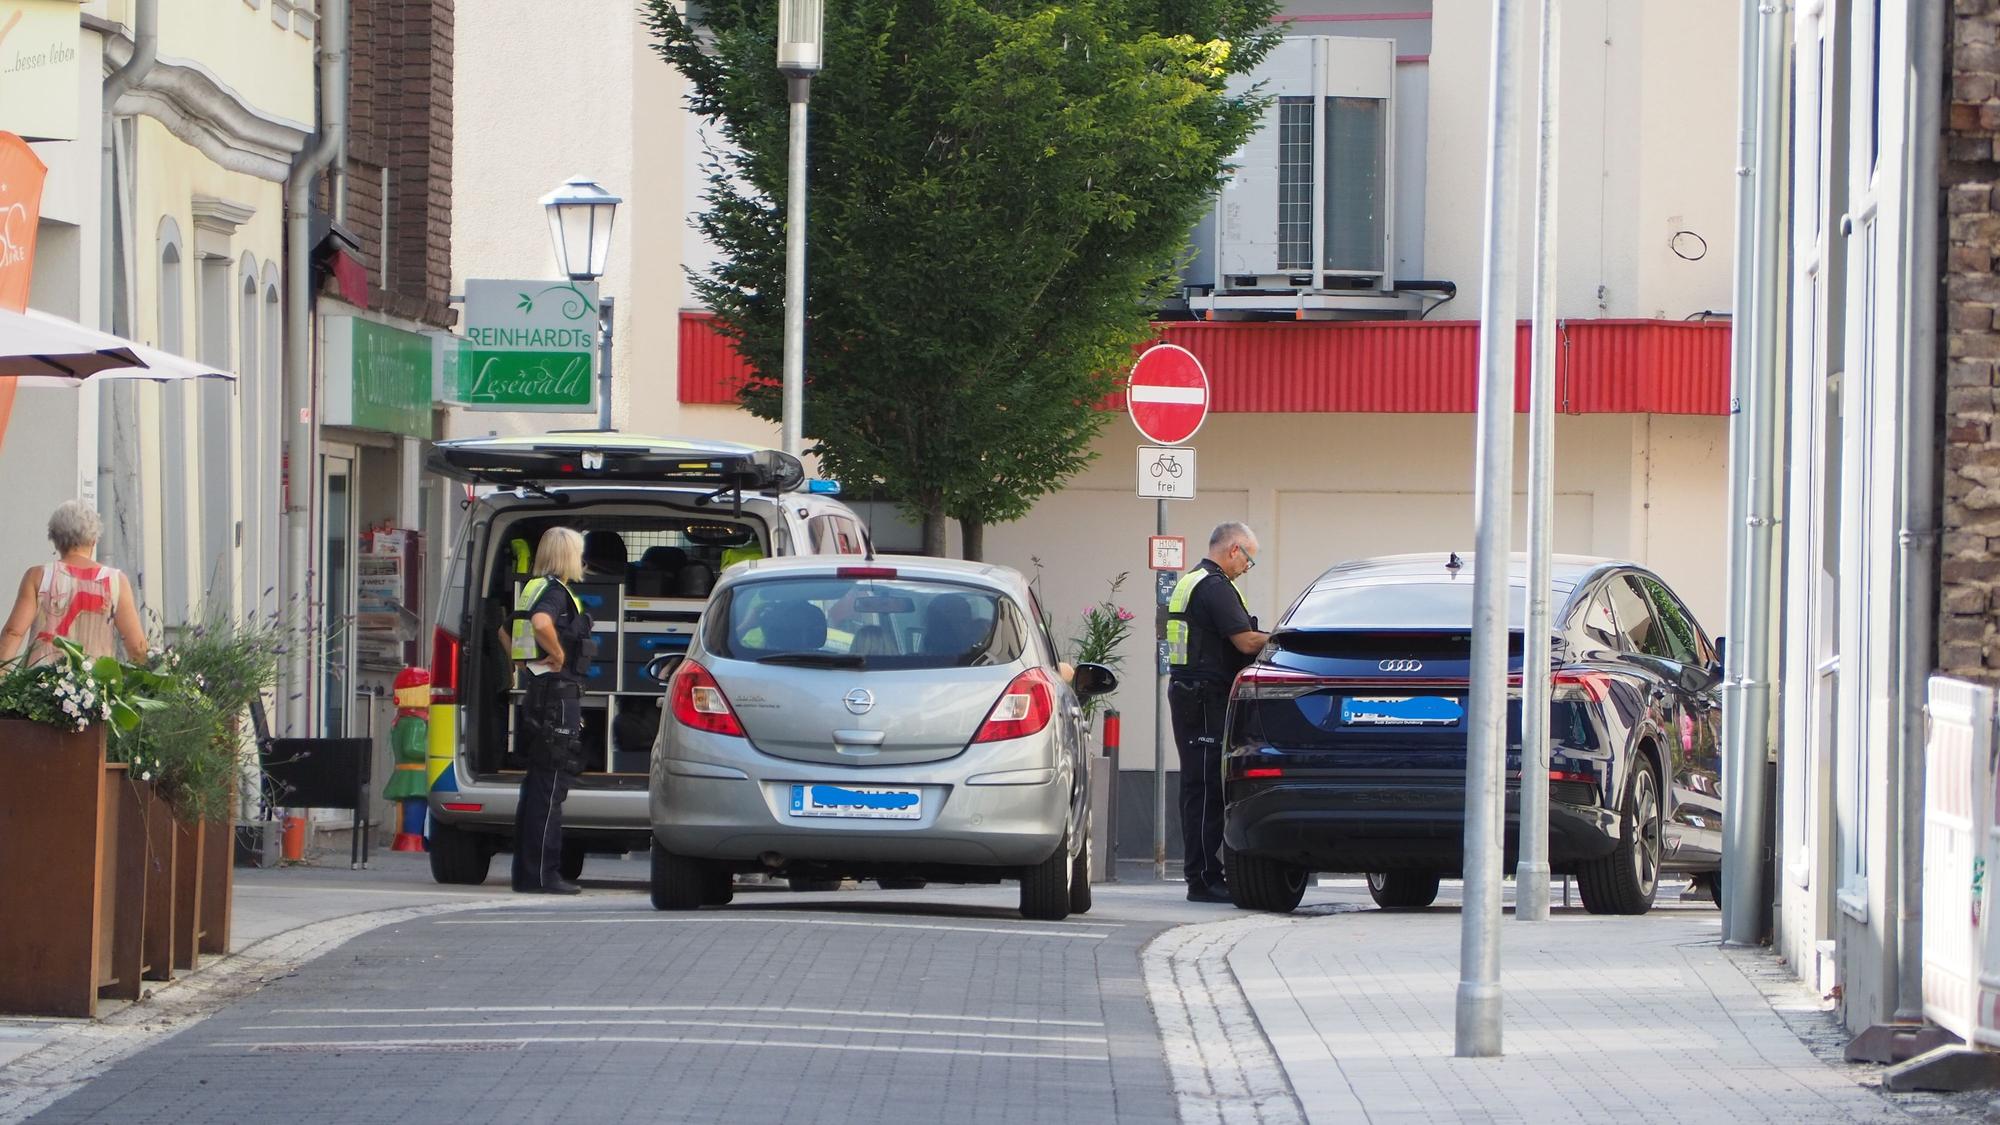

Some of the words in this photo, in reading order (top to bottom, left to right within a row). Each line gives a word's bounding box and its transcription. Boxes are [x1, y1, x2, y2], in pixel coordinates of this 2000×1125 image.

[49, 41, 75, 64] leben
[468, 328, 591, 347] REINHARDTs
[472, 356, 588, 400] Lesewald
[1158, 481, 1176, 491] frei
